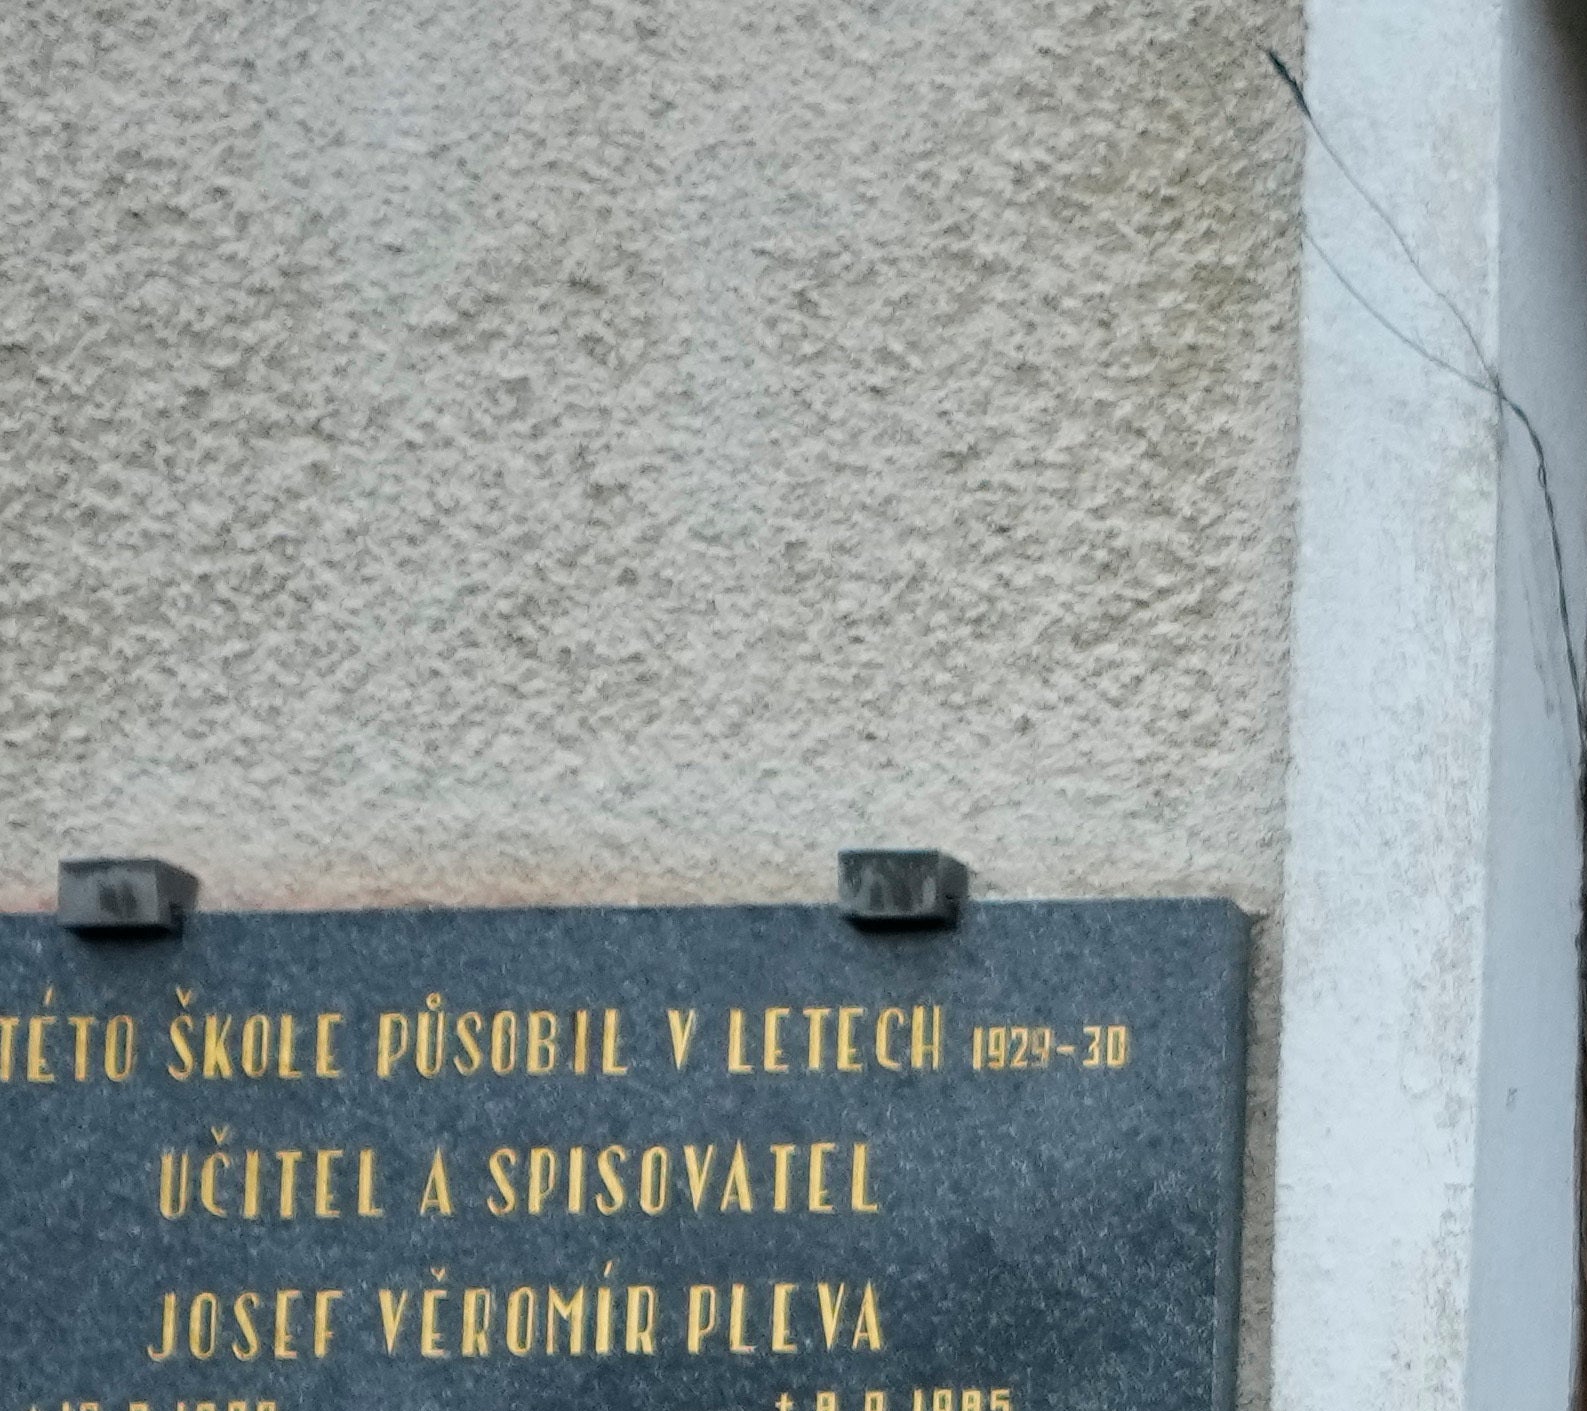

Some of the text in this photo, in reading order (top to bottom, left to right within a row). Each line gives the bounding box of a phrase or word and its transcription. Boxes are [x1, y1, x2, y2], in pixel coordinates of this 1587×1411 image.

[0, 985, 1131, 1083] TÉTO ŠKOLE PŮSOBIL V LETECH 1929-30
[159, 1124, 880, 1220] UČITEL A SPISOVATEL
[146, 1260, 882, 1362] JOSEF VĚROMÍR PLEVA
